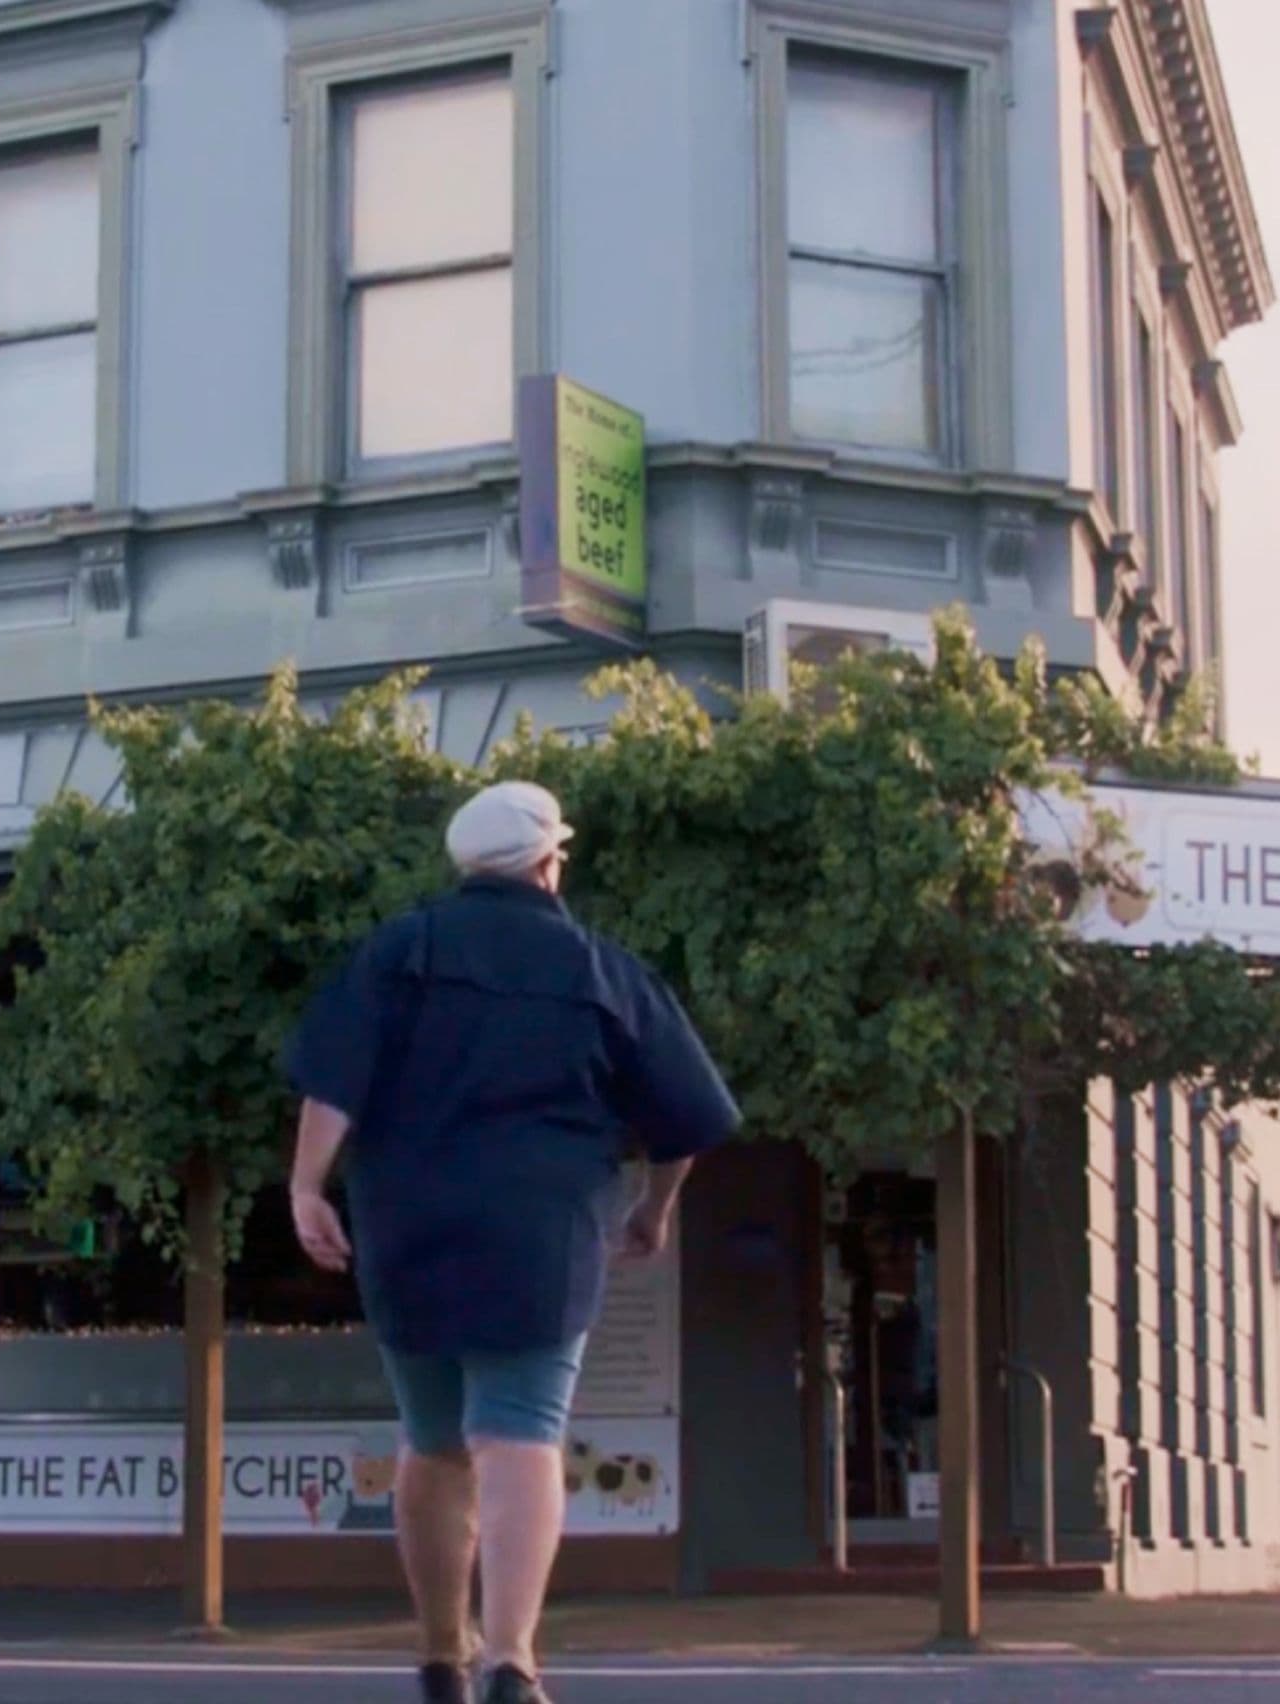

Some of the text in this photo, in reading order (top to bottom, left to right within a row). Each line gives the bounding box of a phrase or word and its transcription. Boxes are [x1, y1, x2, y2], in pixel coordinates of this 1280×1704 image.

[576, 485, 628, 531] aged
[577, 522, 625, 577] beef
[77, 1456, 144, 1497] FAT
[157, 1455, 345, 1498] BCHER
